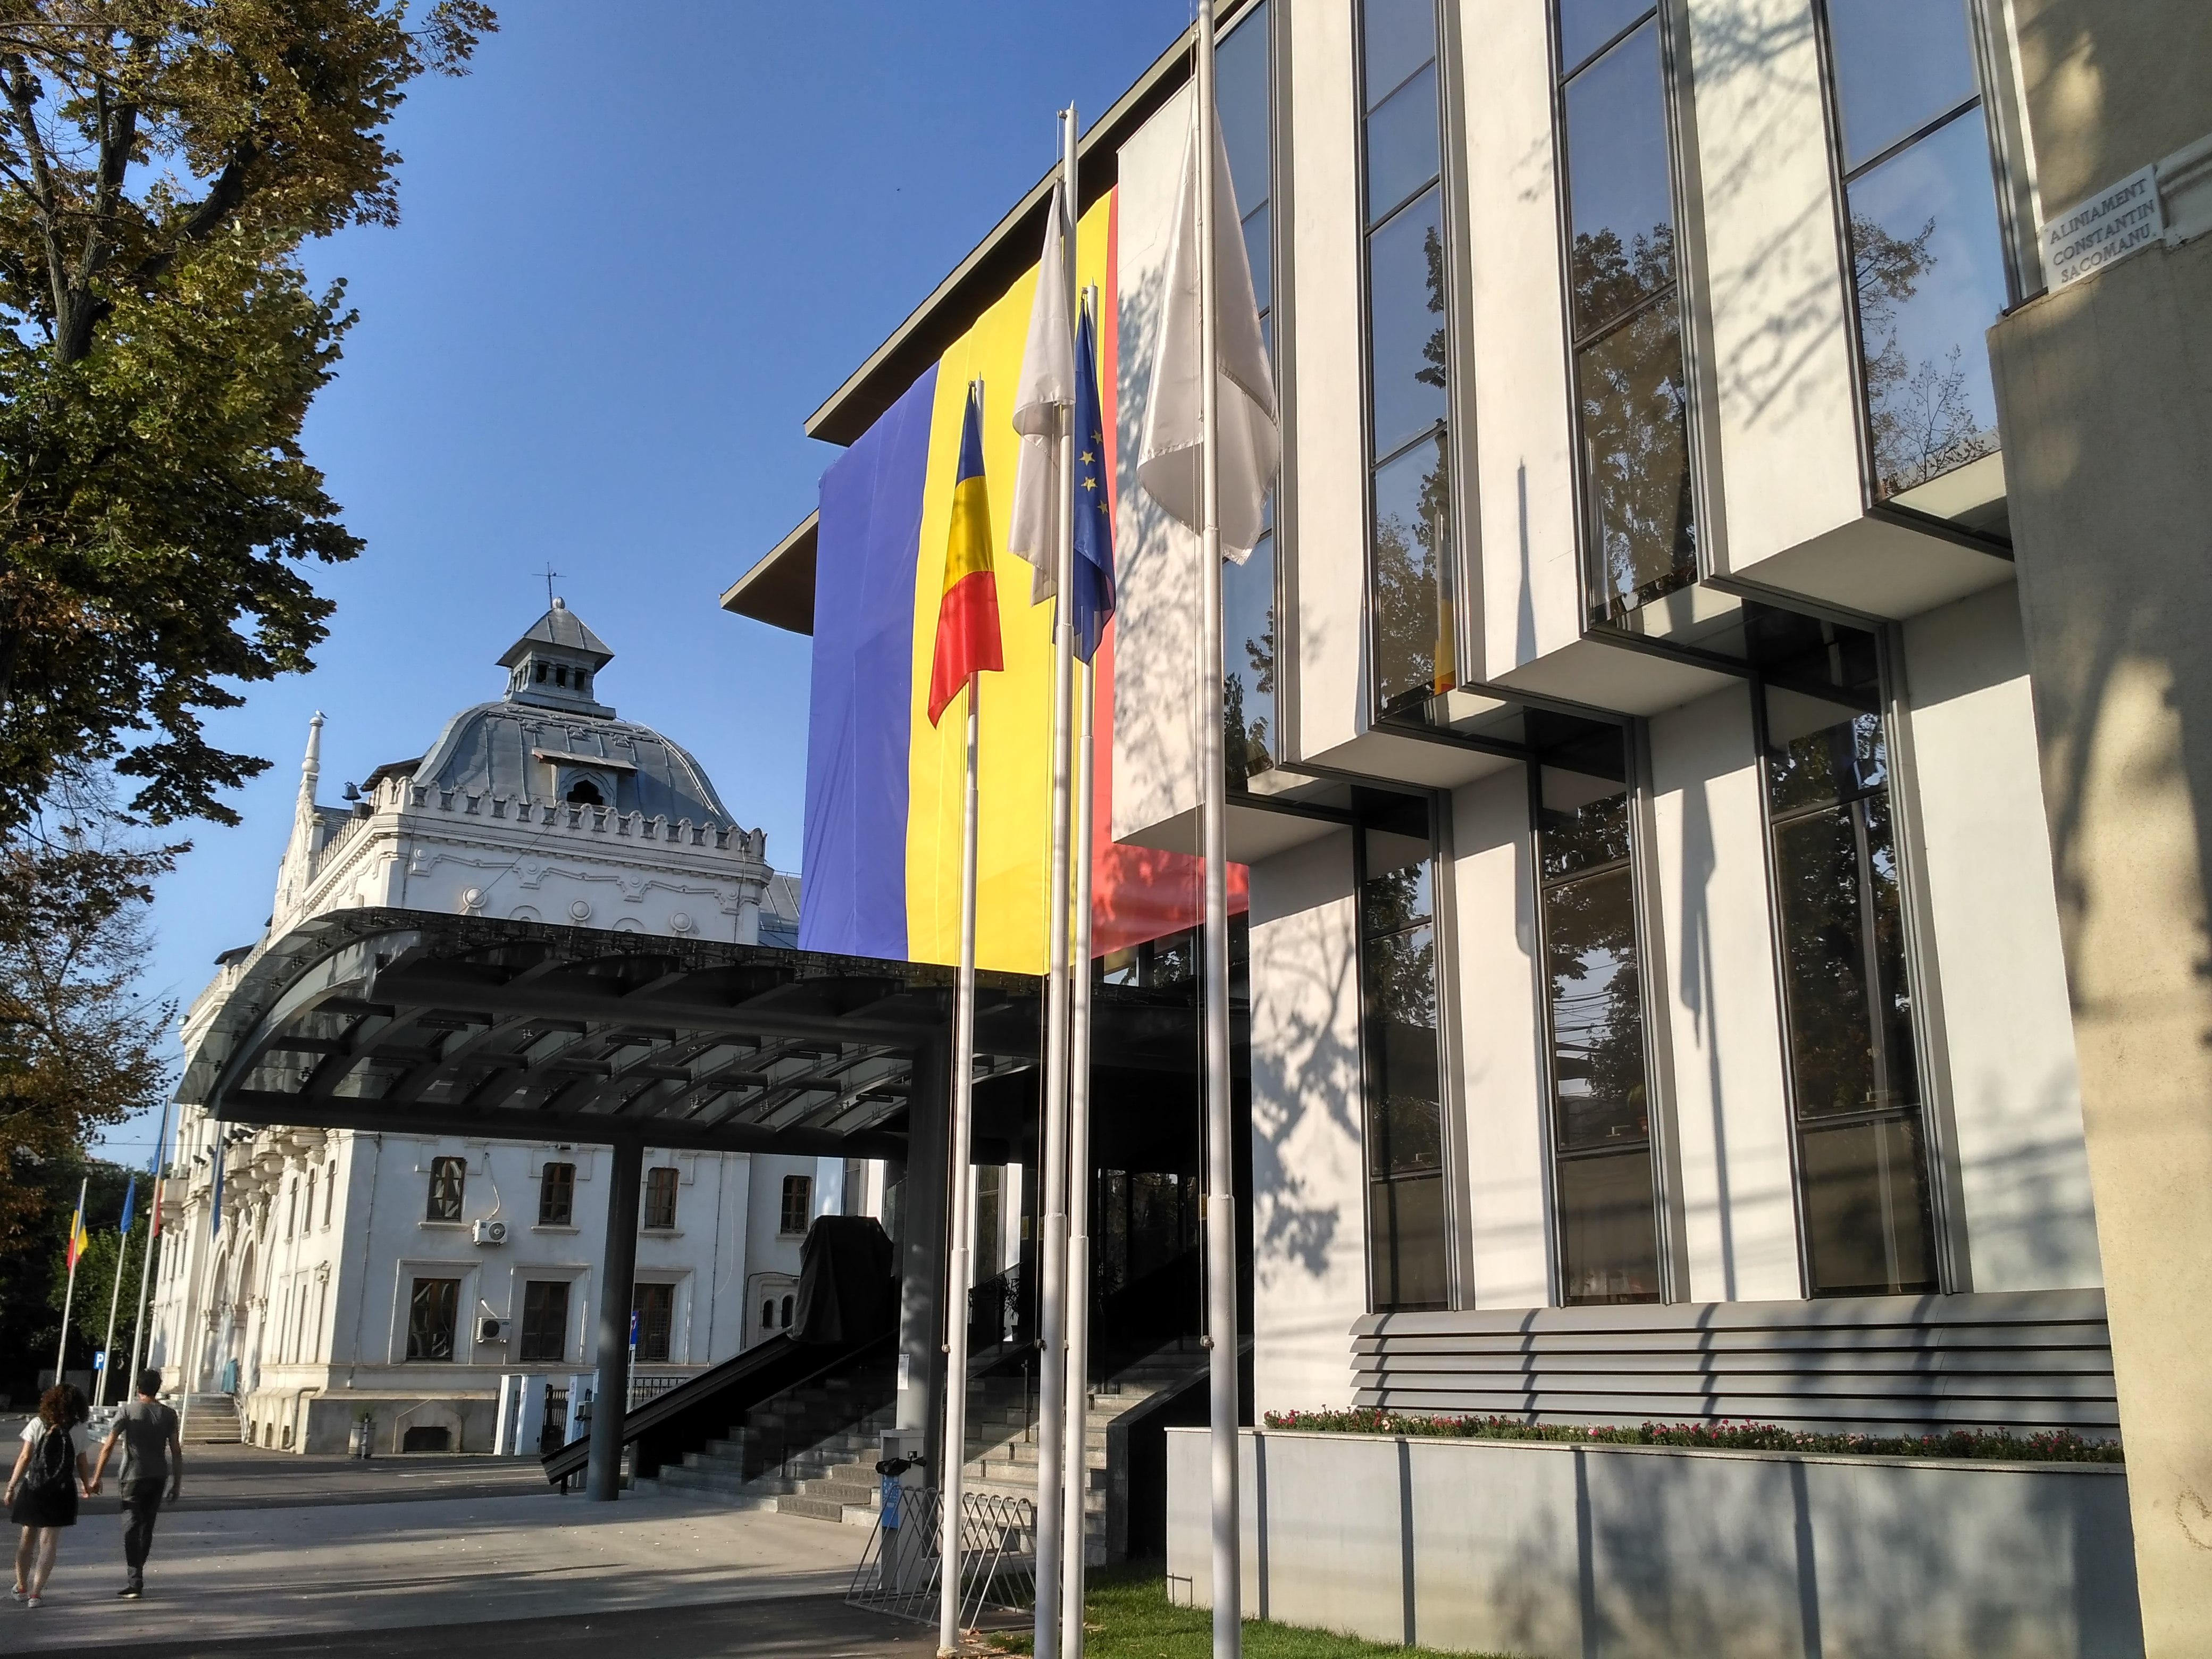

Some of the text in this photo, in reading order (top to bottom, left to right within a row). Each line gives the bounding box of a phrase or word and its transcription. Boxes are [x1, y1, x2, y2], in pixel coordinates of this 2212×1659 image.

[2050, 178, 2147, 245] ALINIAMENT
[2053, 199, 2155, 266] CONSTANTIN
[2061, 223, 2150, 283] SACOMANU
[96, 1353, 104, 1367] P
